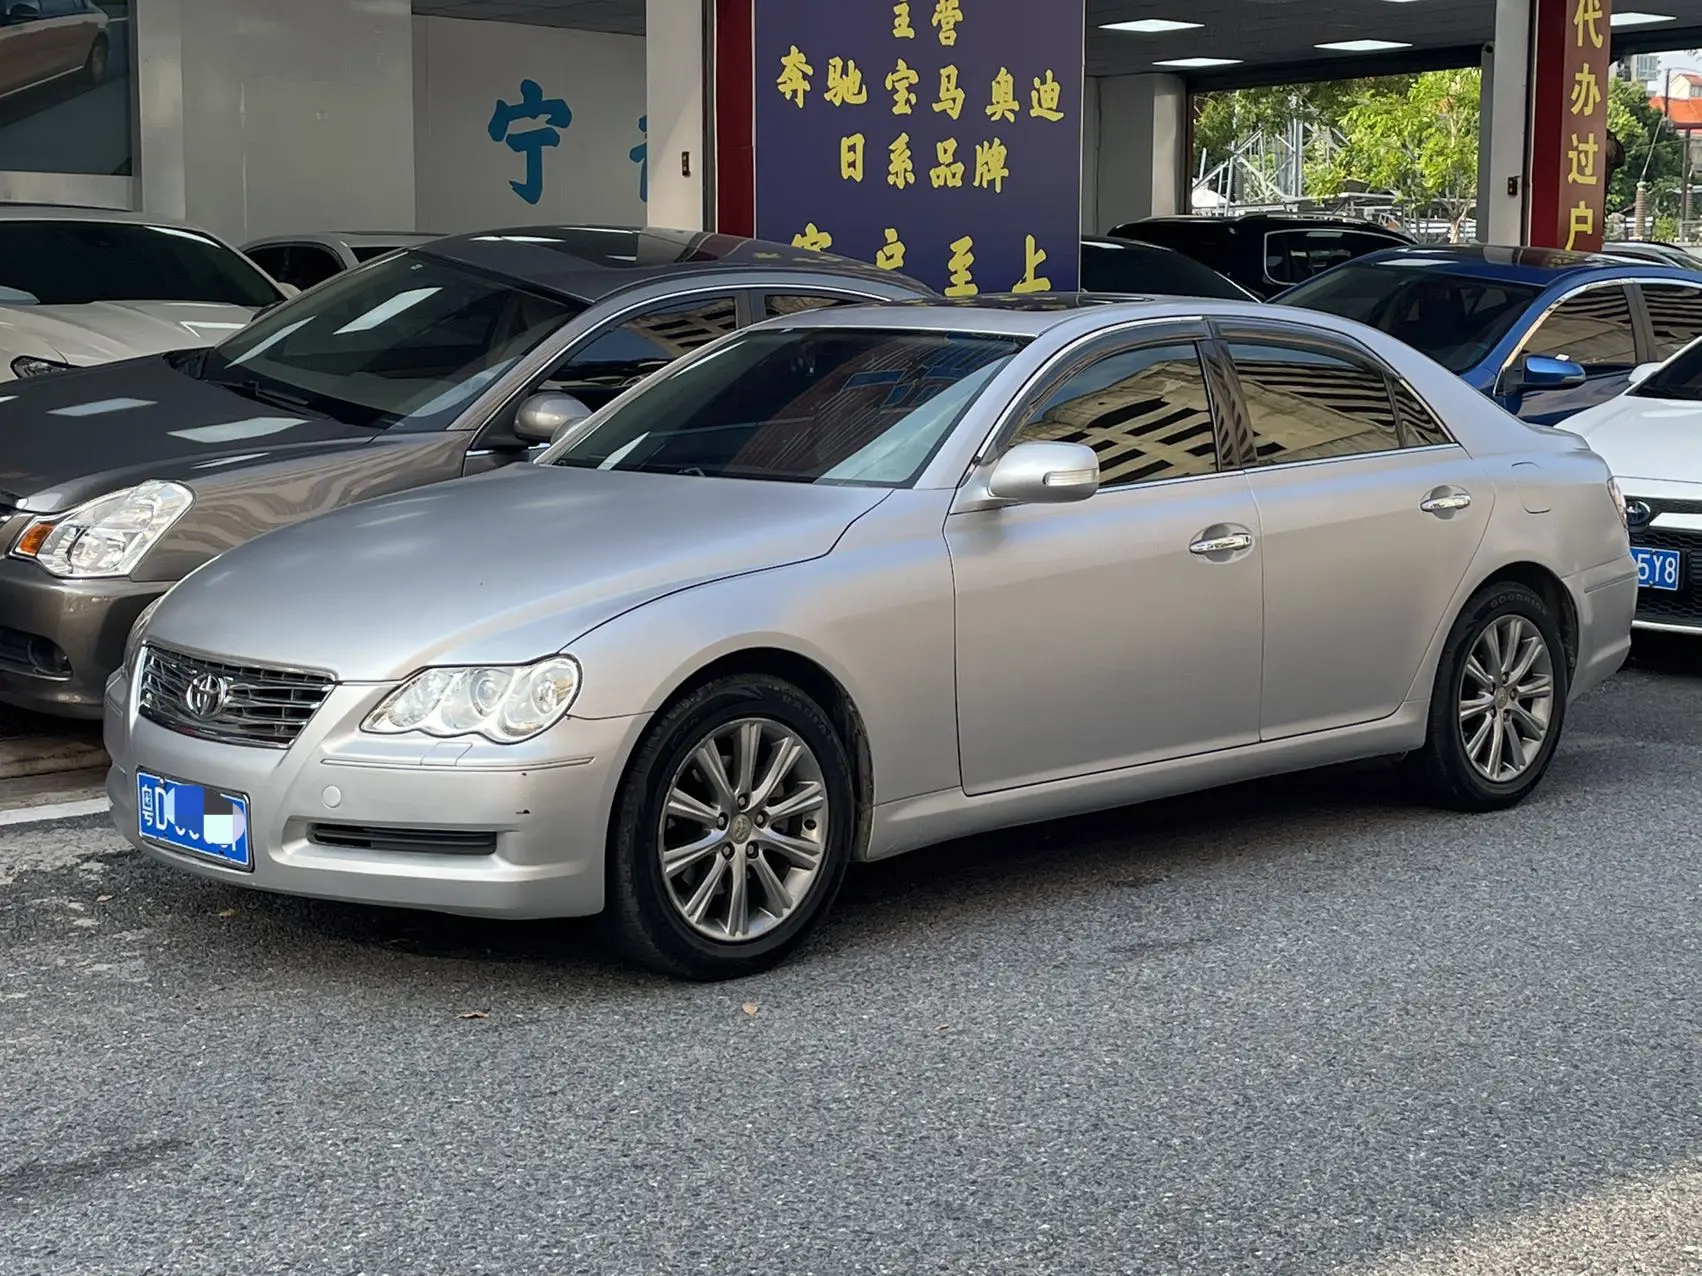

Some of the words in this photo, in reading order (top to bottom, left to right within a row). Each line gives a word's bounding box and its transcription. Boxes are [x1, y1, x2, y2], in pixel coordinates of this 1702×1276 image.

[776, 44, 1065, 123] 奔驰宝马奥迪
[1565, 0, 1604, 251] 代办过户
[487, 77, 648, 205] 宁
[840, 132, 1010, 194] 日系品牌
